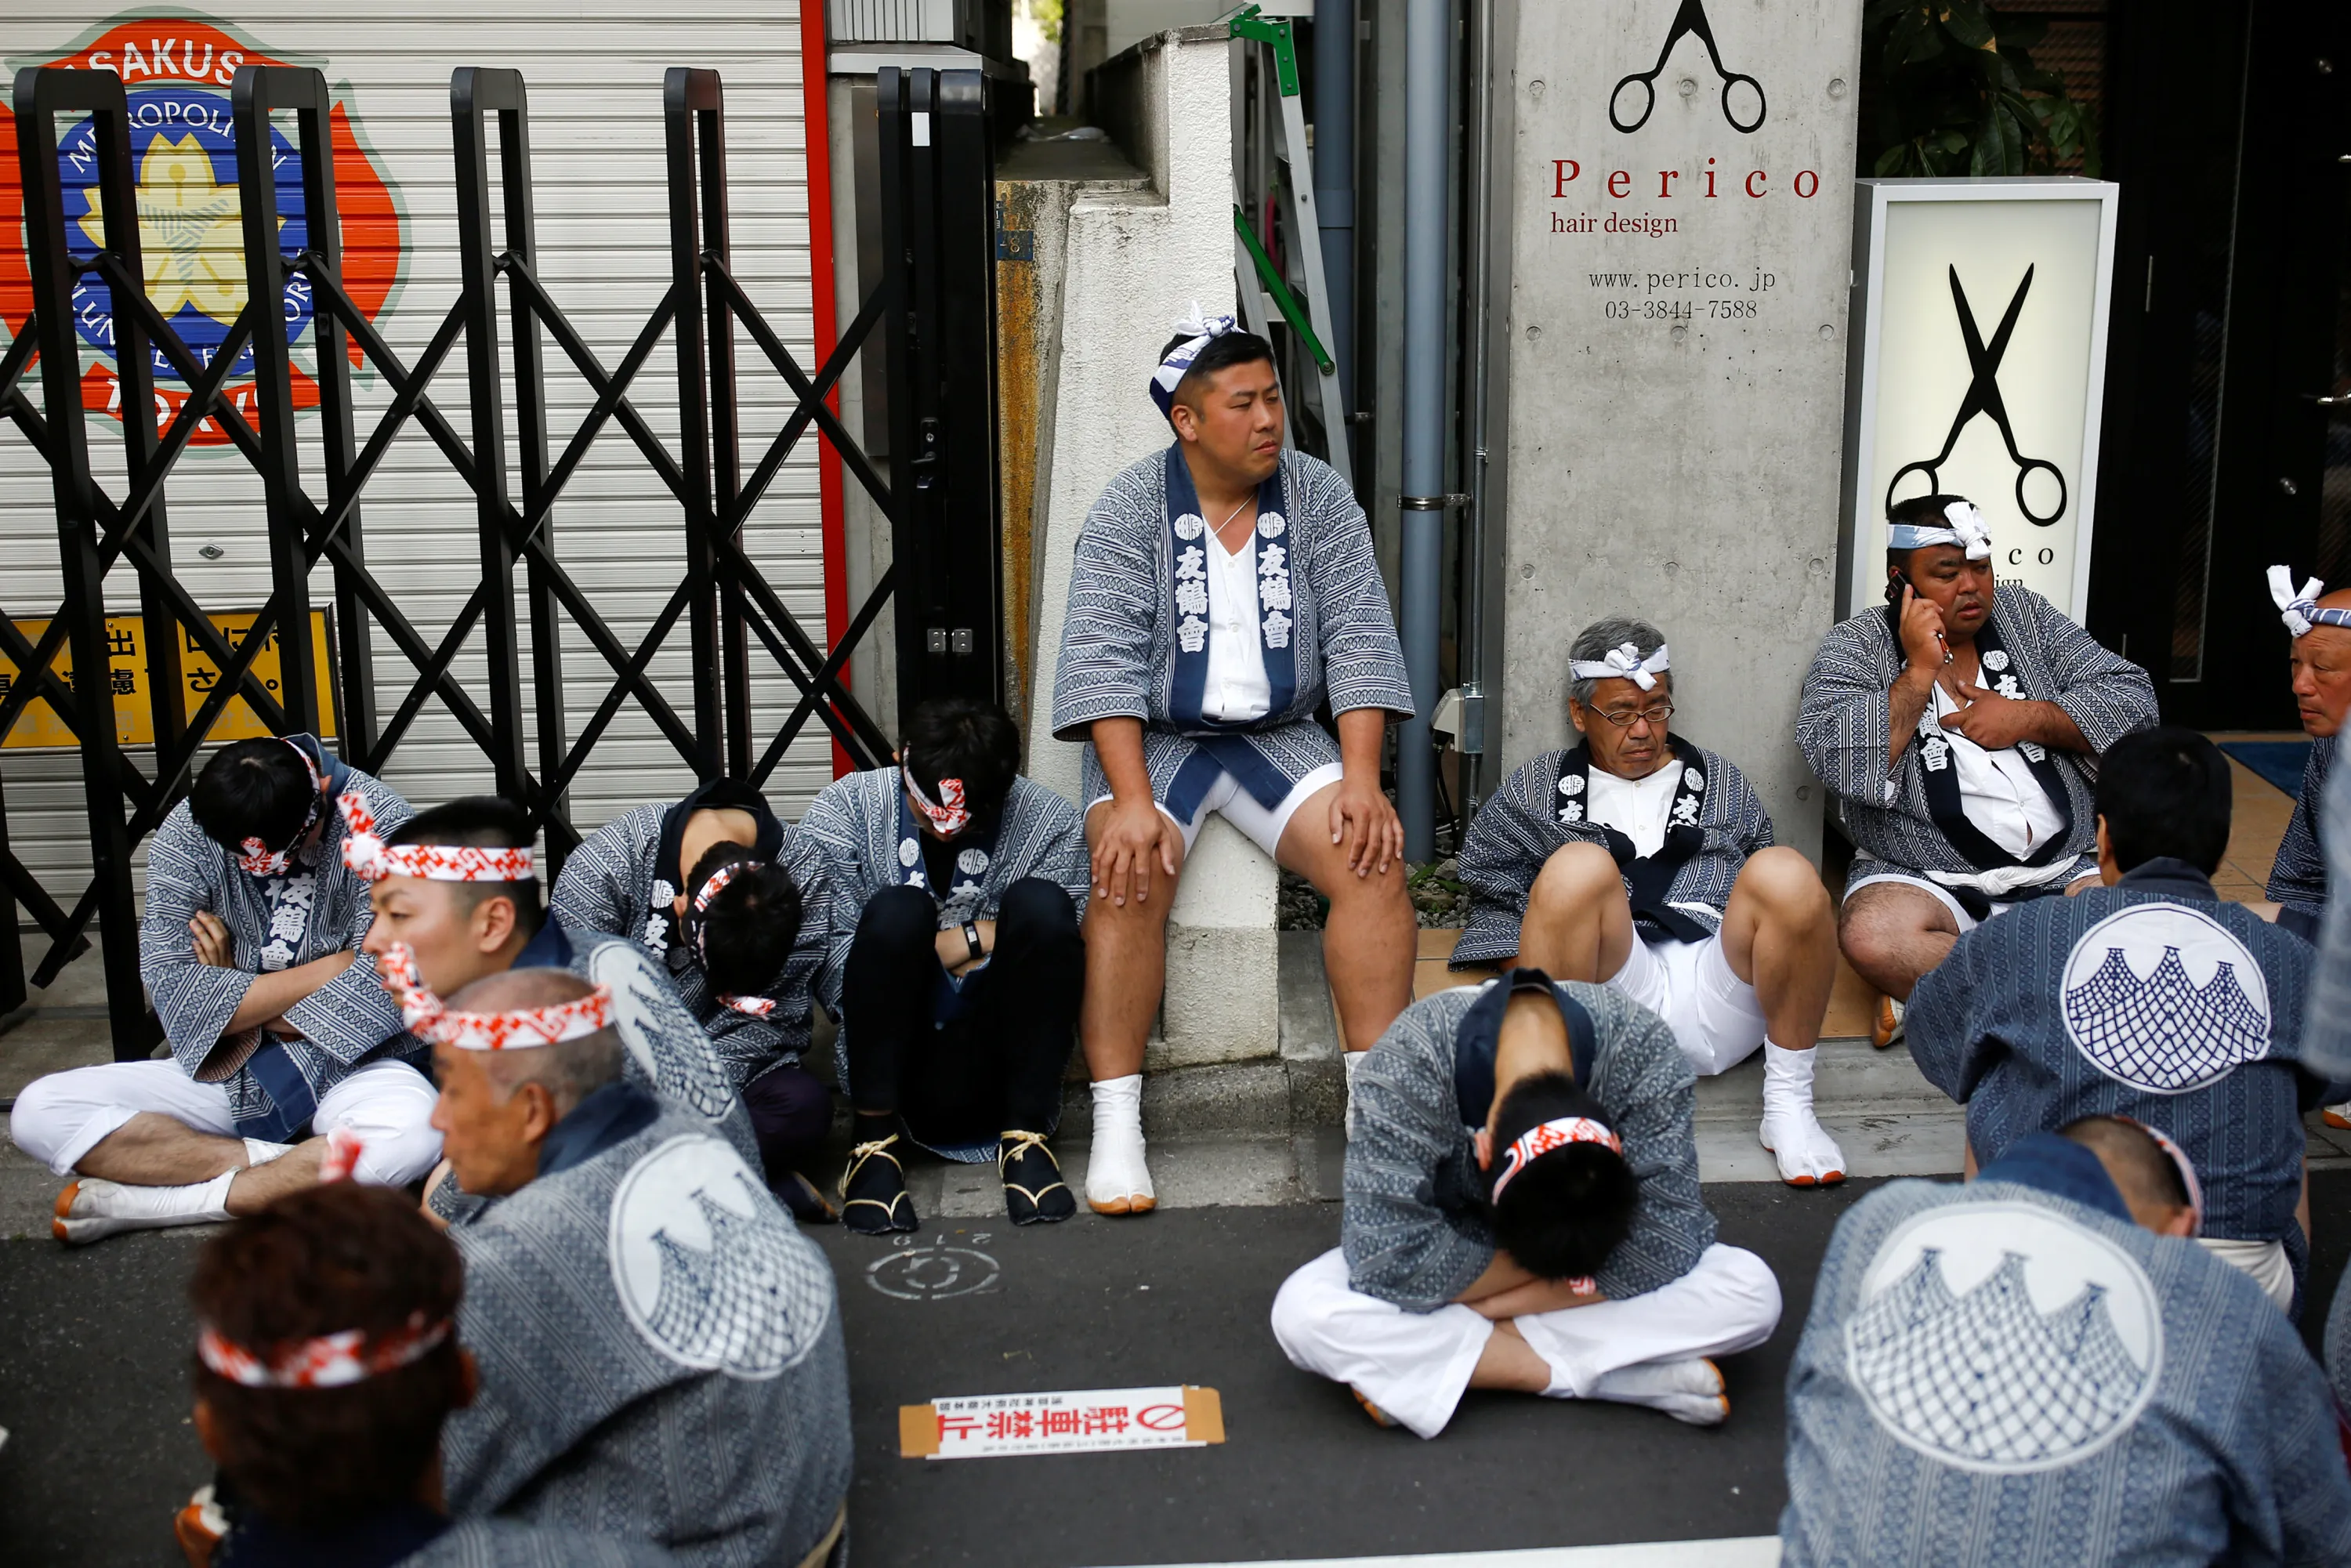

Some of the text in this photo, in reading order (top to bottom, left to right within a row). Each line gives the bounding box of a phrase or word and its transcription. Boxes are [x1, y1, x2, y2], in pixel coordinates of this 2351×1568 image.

[64, 38, 267, 85] SAKUS
[1550, 157, 1820, 199] Perico
[1551, 212, 1679, 238] hair design
[1588, 266, 1777, 295] www.perico.jp
[1605, 299, 1758, 320] 03-3844-7588
[936, 1405, 1131, 1443] 駐車禁止
